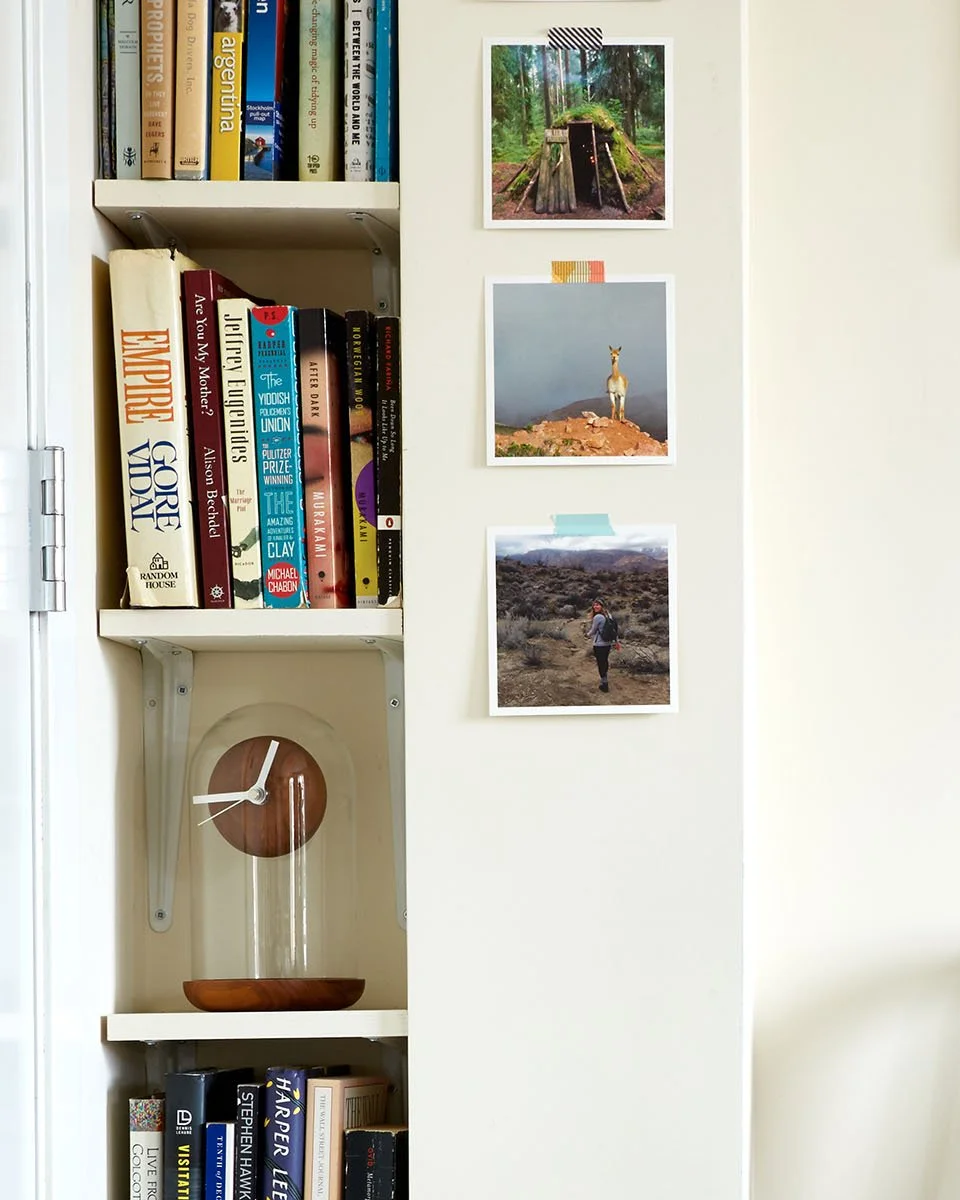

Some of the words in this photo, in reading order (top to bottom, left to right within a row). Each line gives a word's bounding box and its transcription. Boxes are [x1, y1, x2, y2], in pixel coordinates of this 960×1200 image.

[352, 21, 360, 61] BETWEEN
[309, 48, 317, 73] magic
[352, 64, 360, 80] THE
[214, 37, 237, 133] argentina
[311, 75, 320, 84] of
[308, 87, 319, 116] tidying
[352, 83, 360, 111] WORLD
[308, 119, 317, 129] up
[352, 114, 360, 130] AND
[352, 133, 360, 145] ME
[194, 294, 205, 315] Are
[196, 317, 207, 340] You
[195, 343, 208, 363] My
[223, 314, 244, 372] Jeffrey
[384, 326, 392, 360] RICHARD
[352, 327, 363, 383] NORWEGIAN
[120, 328, 174, 424] EMPIRE
[260, 371, 283, 389] The
[309, 361, 319, 389] AFTER
[199, 367, 213, 416] Mother?
[258, 392, 290, 405] YIDDISH
[259, 407, 291, 416] POLICEMEN'S
[310, 394, 320, 417] DARK
[225, 379, 249, 463] Eugenides
[261, 417, 290, 433] UNION
[262, 448, 291, 460] PULITZER
[203, 446, 214, 486] Alison
[263, 460, 292, 474] PRIZE-
[127, 438, 155, 533] VIDAL
[151, 440, 182, 533] GORE
[263, 474, 293, 485] WINNING
[206, 489, 220, 538] Bechdel
[264, 491, 294, 515] THE
[267, 517, 293, 526] AMAZING
[312, 491, 327, 558] MURAKAMI
[359, 492, 368, 542] MURAKAMI
[267, 541, 295, 558] CLAY
[140, 572, 178, 580] RANDOM
[145, 581, 176, 589] HOUSE
[267, 568, 298, 579] MICHAEL
[268, 580, 298, 593] CHABON
[240, 1092, 253, 1154] STEPHEN
[273, 1077, 291, 1156] HARPER
[147, 1147, 159, 1175] LIVE
